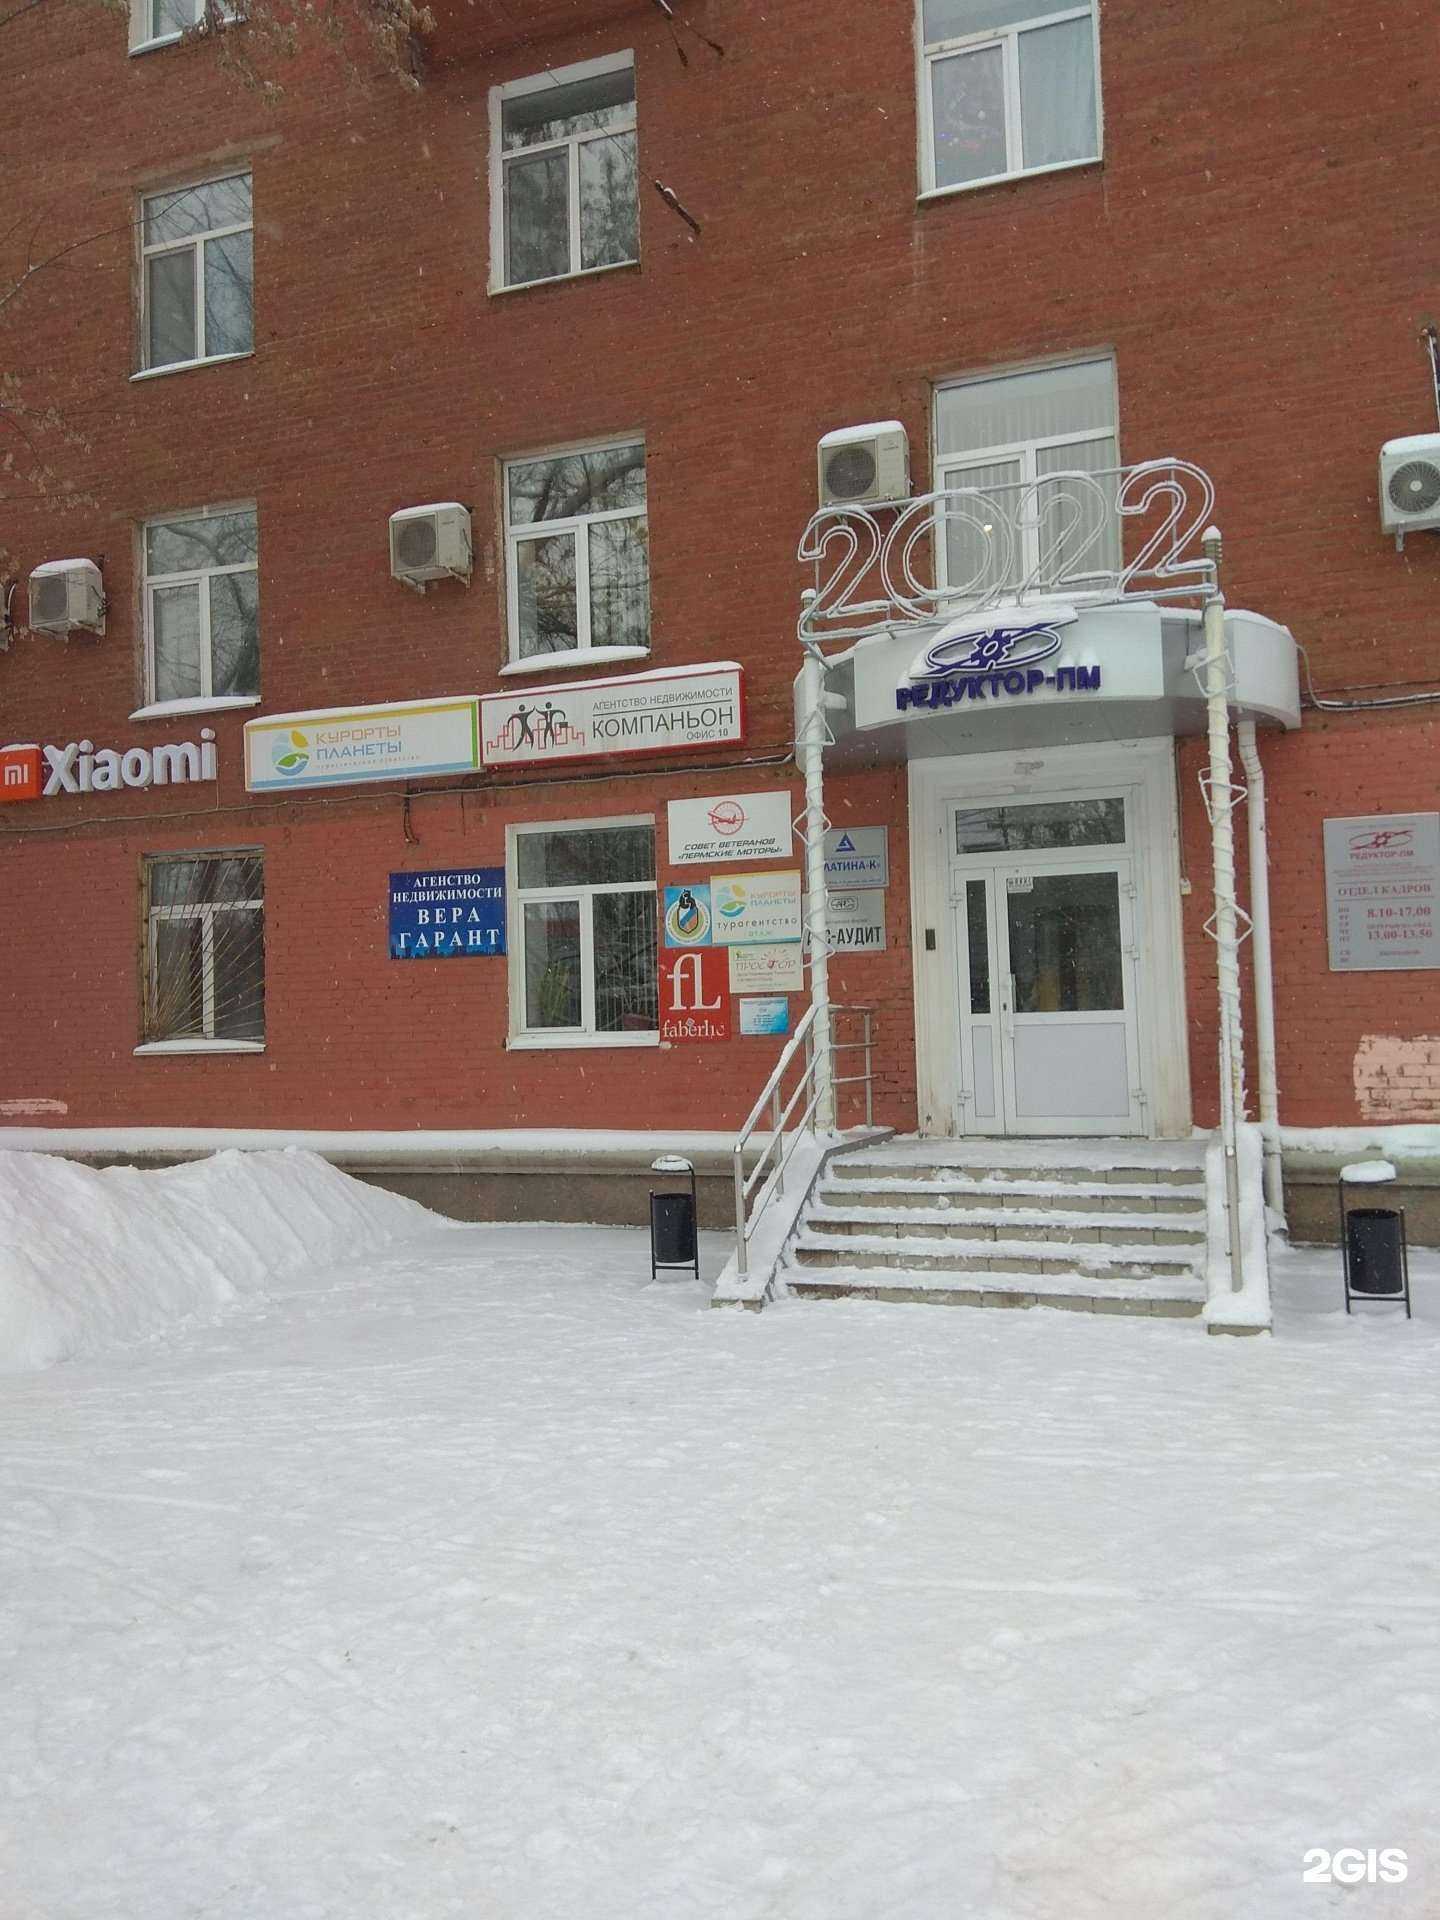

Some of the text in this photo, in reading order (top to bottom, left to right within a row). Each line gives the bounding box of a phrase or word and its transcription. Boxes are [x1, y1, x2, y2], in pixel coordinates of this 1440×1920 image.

[797, 457, 1216, 641] 2022
[895, 665, 1102, 711] РЕДУКТОР-ПМ
[592, 687, 733, 711] АГЕНТСТВО НЕДВИЖИМОСТИ
[592, 706, 733, 739] КОМПАНЬОН
[316, 725, 402, 744] КУРОРТЫ
[686, 728, 729, 741] ОФИС 10
[316, 740, 403, 761] ПЛАНЕТЫ
[42, 727, 218, 796] Xiaomi
[684, 837, 776, 852] СОВЕТ ВЕТЕРАНОВ
[413, 873, 481, 888] АГЕНСТВО
[393, 887, 502, 904] НЕДВИЖИМОСТИ
[417, 907, 481, 925] ВЕРА
[717, 916, 798, 931] турагентство
[399, 929, 500, 949] ГАРАНТ
[662, 1017, 726, 1039] faberlic
